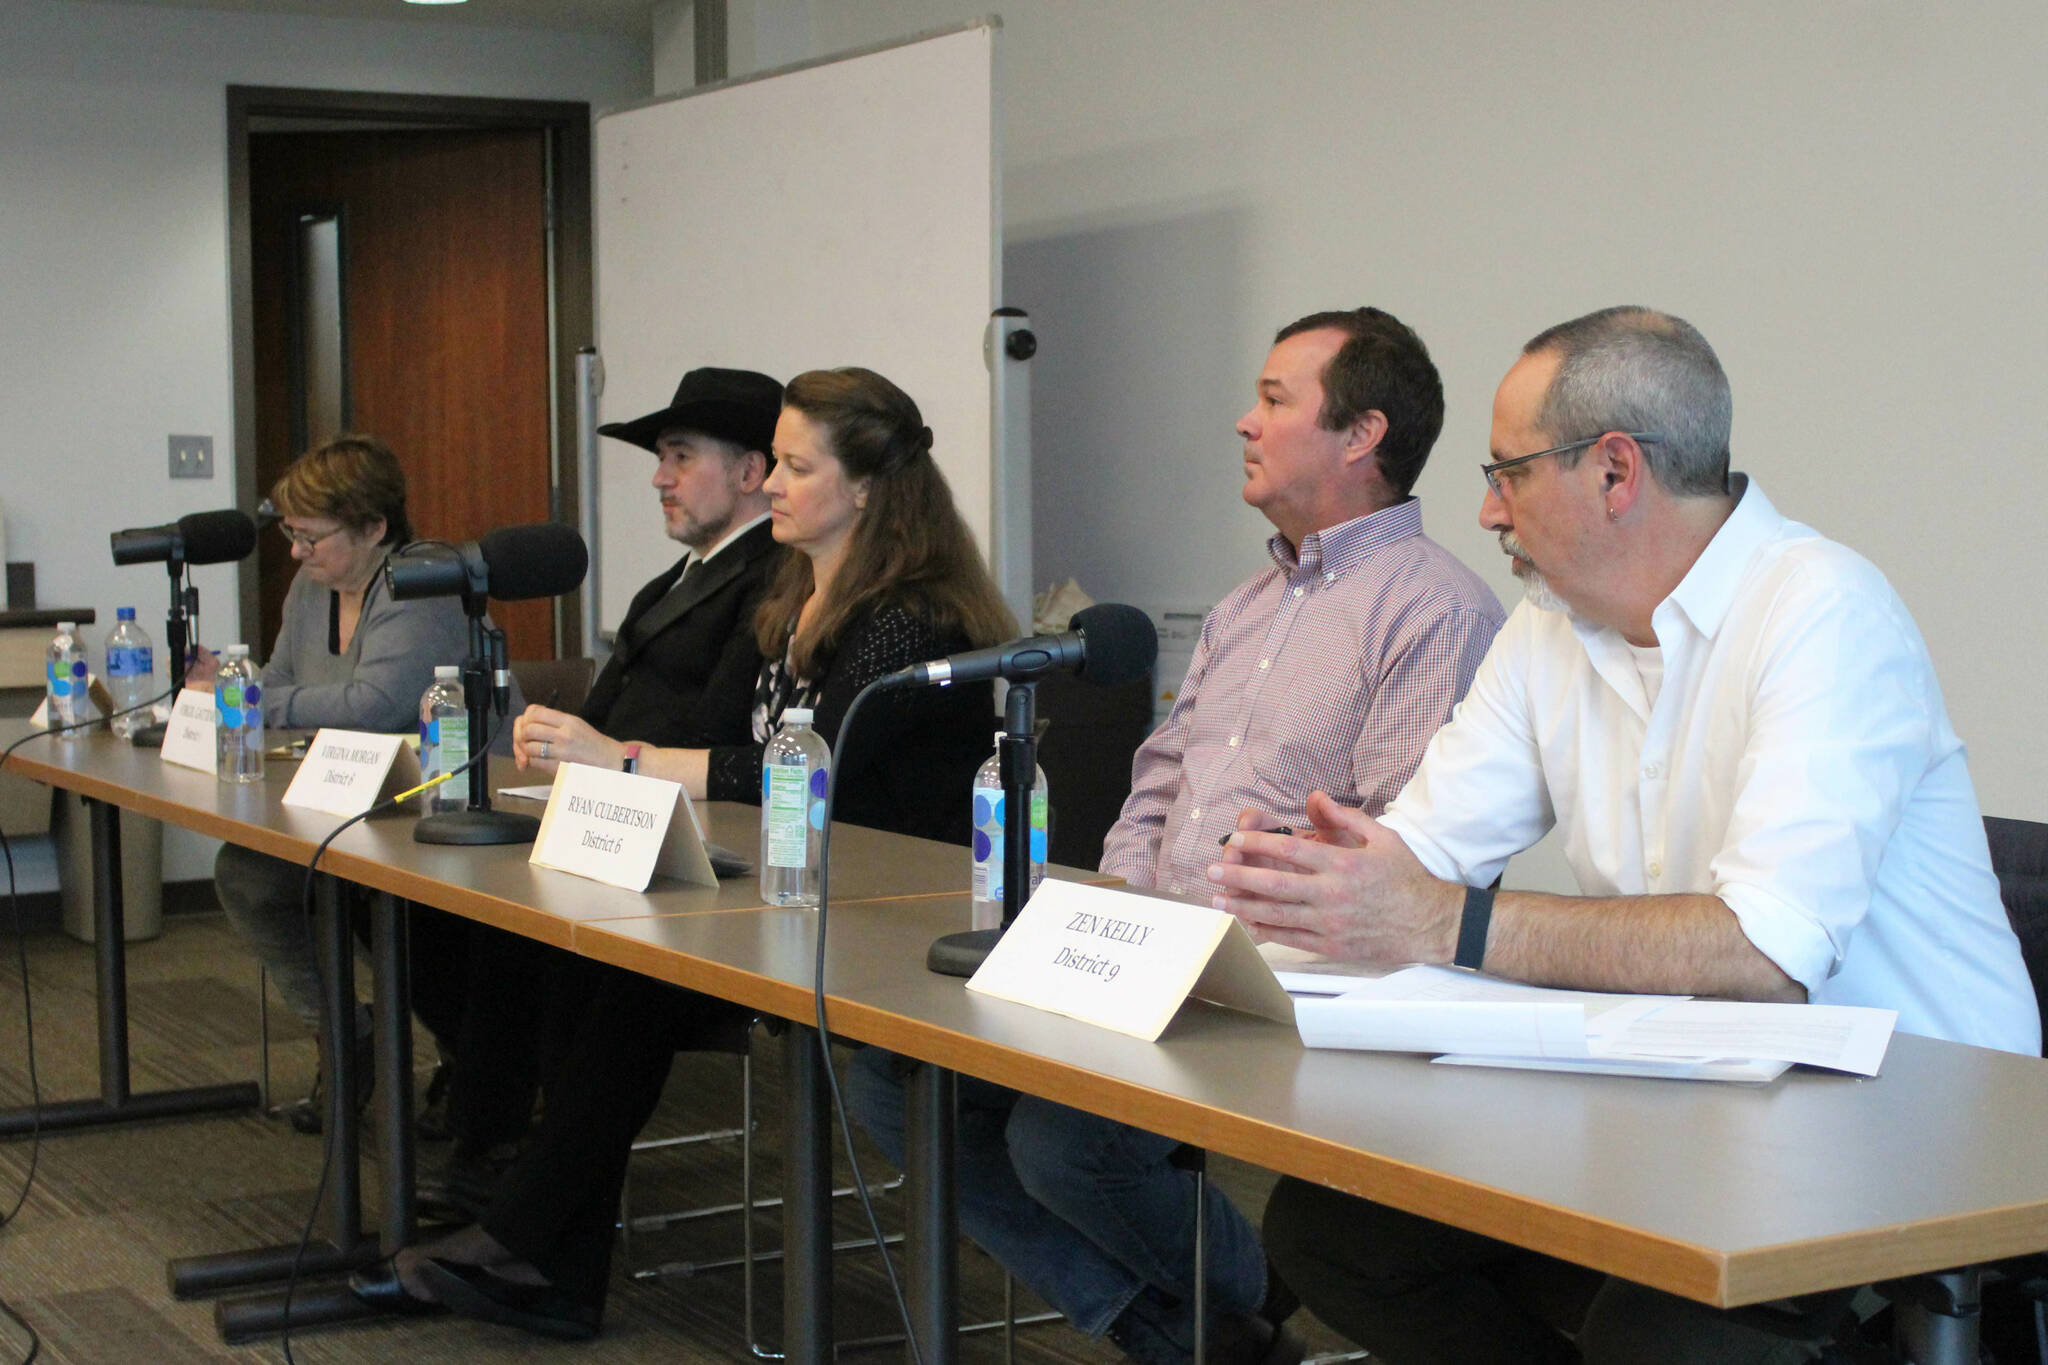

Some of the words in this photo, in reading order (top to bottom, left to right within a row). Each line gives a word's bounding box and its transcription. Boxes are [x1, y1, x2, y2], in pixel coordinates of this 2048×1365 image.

[323, 769, 349, 786] District
[568, 795, 595, 816] RYAN
[594, 801, 657, 830] CULBERTSON
[581, 830, 615, 853] District
[614, 838, 624, 854] 6
[1066, 911, 1104, 935] ZEN
[1098, 918, 1154, 946] KELLY
[1053, 946, 1110, 976] District
[1103, 964, 1121, 983] 9
